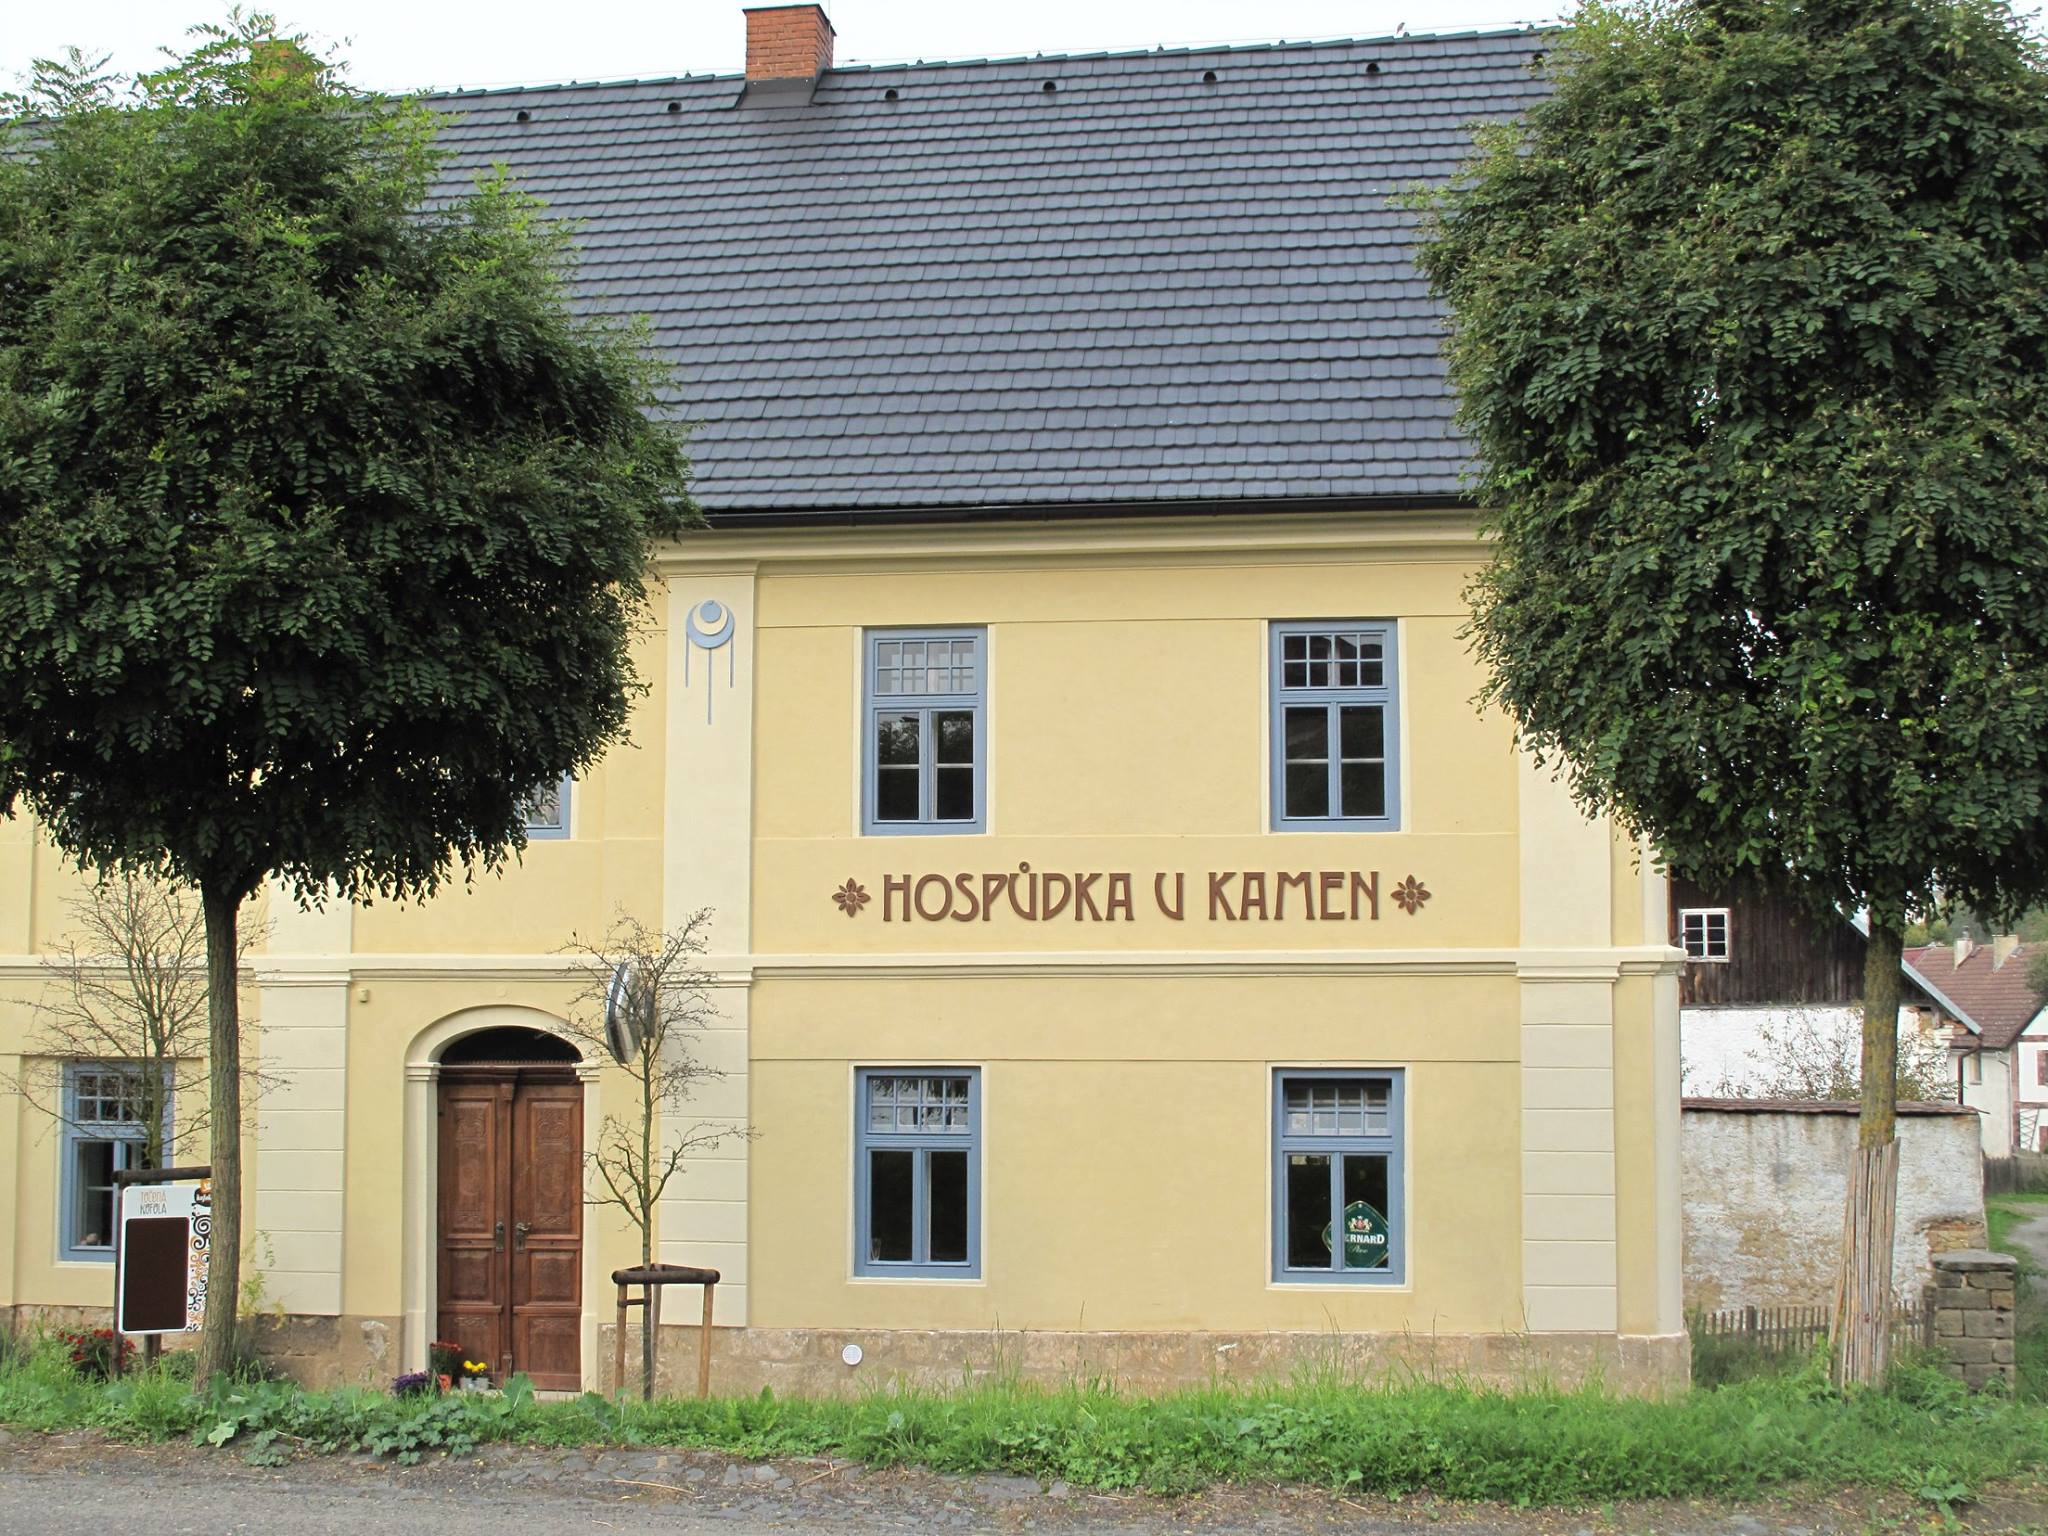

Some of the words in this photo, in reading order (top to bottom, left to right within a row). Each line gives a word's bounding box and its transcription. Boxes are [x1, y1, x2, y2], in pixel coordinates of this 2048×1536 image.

[883, 861, 1135, 921] HOSPŮDKA
[1154, 872, 1184, 920] U
[1208, 871, 1379, 920] KAMEN
[140, 1203, 167, 1215] KOFOLA
[1344, 1234, 1385, 1244] ERNARD
